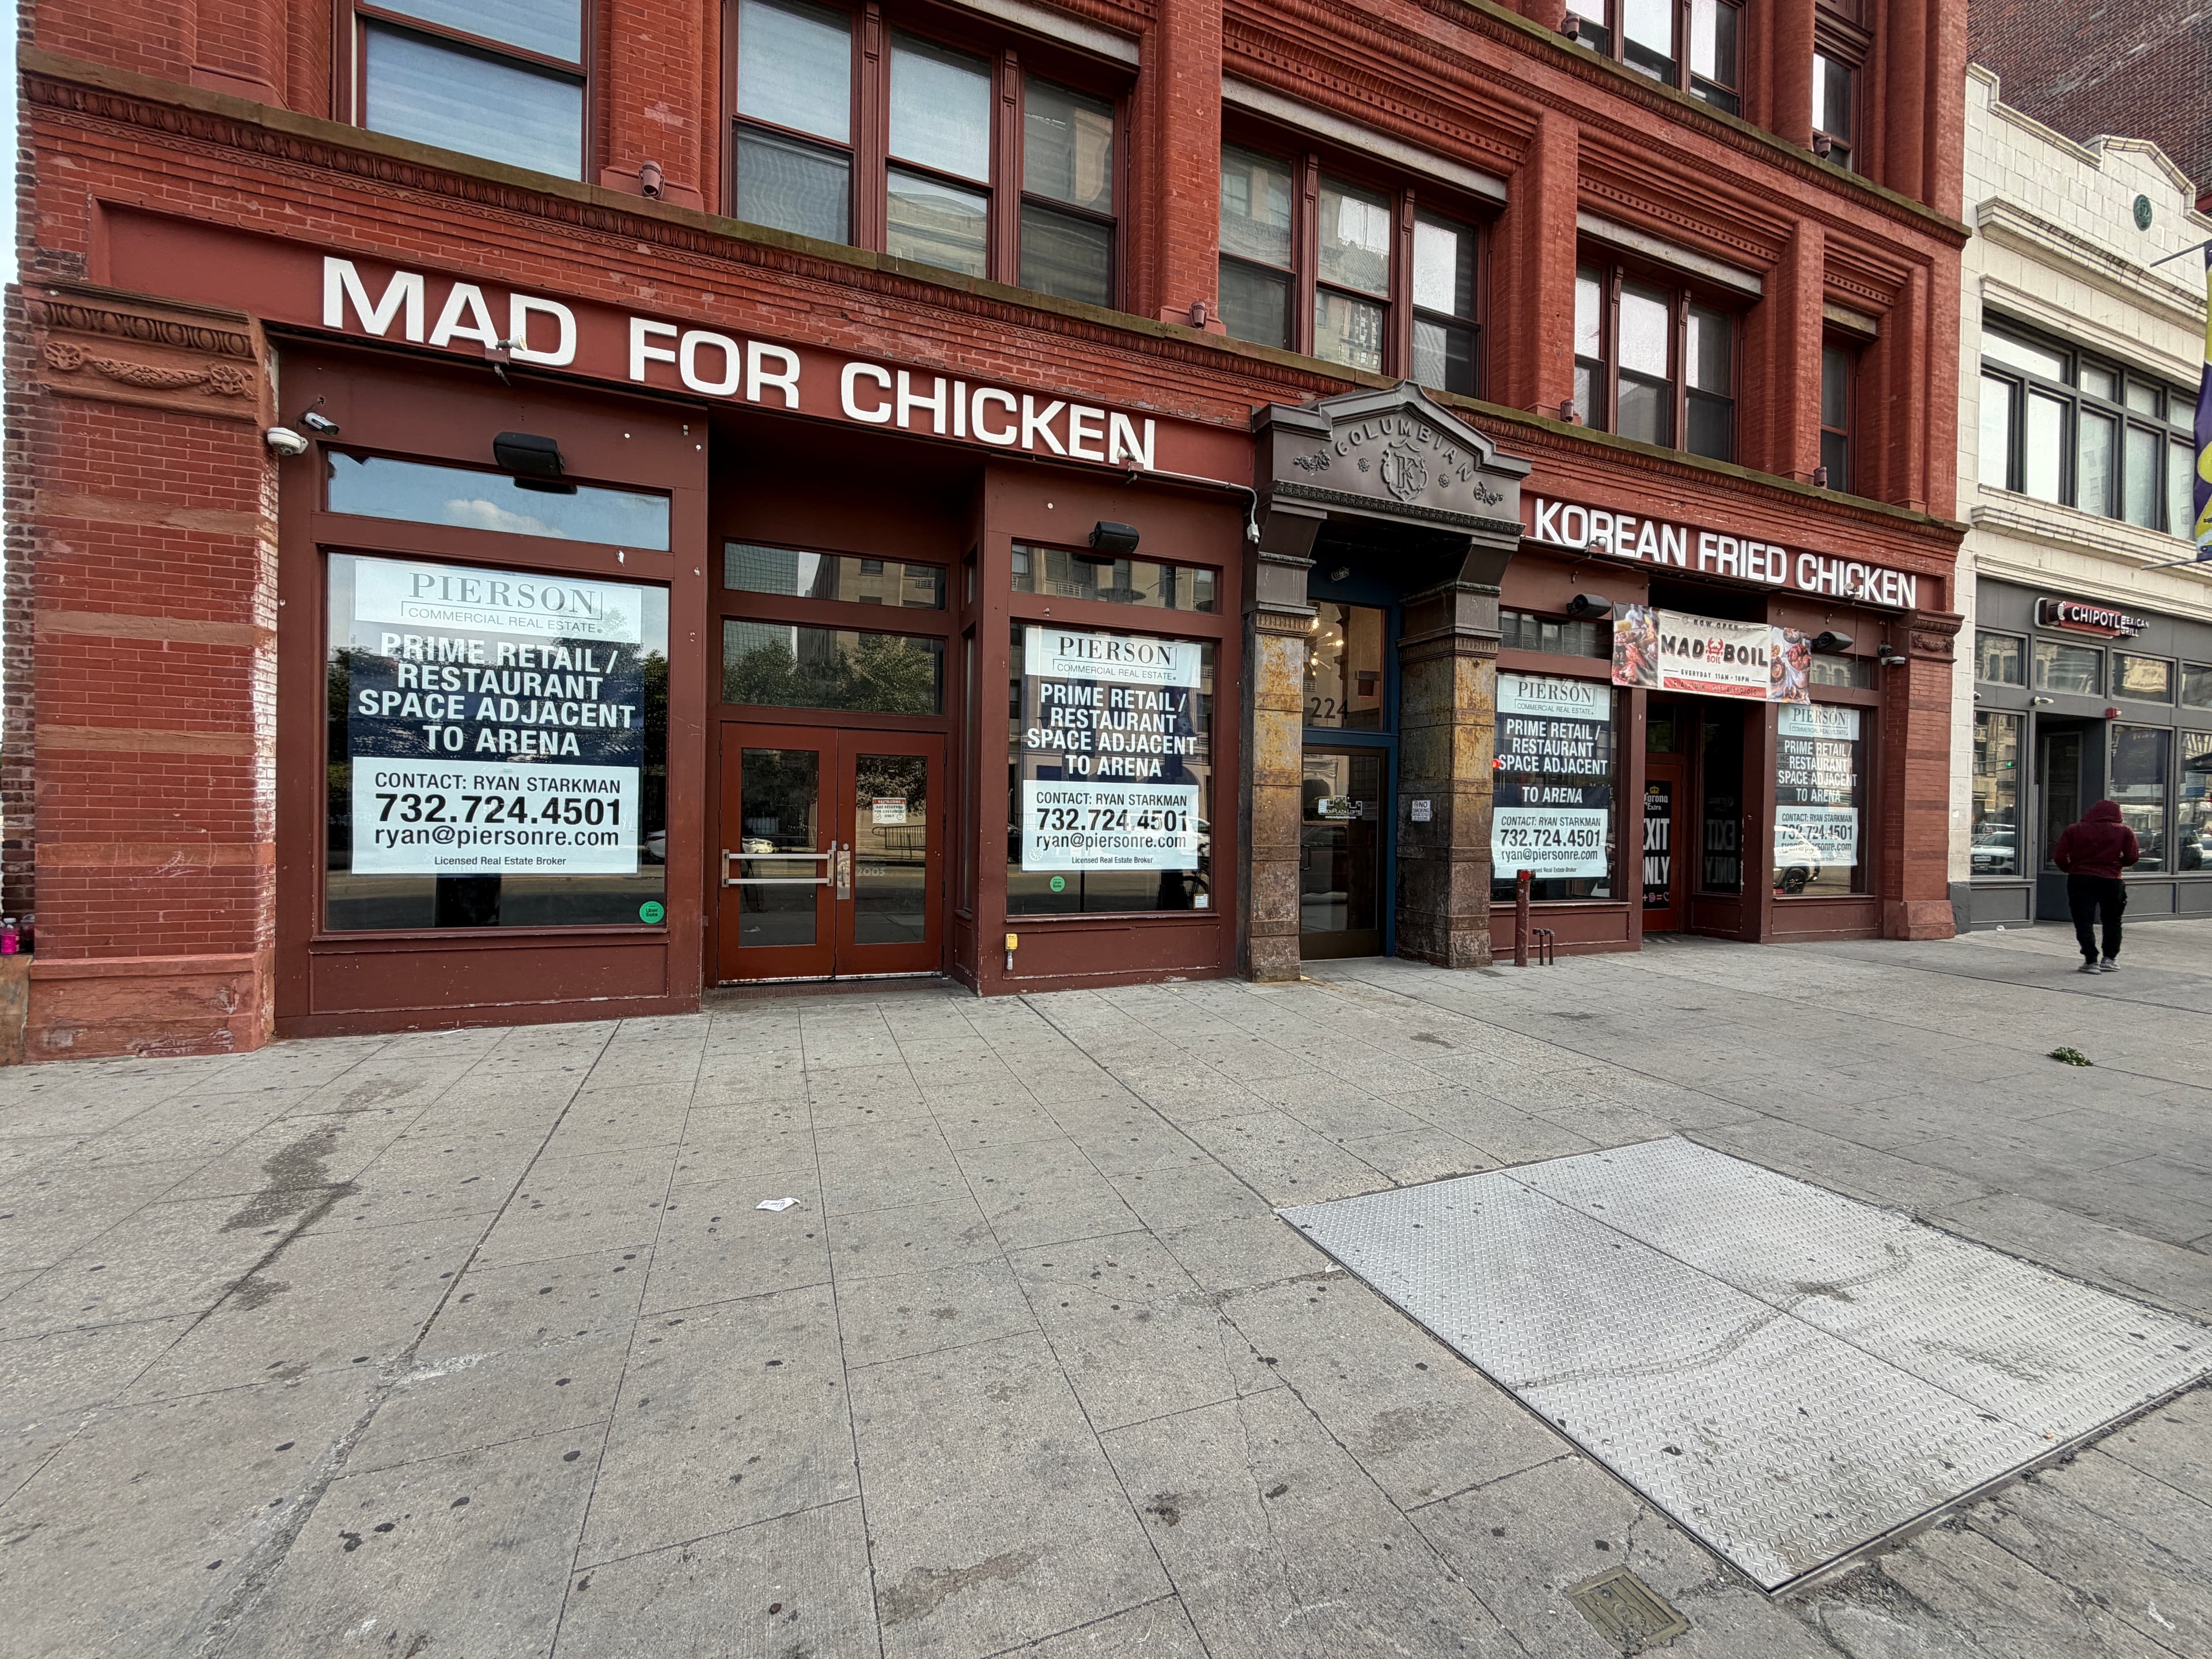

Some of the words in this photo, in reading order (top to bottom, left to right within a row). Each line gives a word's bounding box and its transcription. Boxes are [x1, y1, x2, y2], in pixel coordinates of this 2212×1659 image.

[323, 256, 577, 366] MAD
[630, 317, 800, 409] FOR
[840, 362, 1155, 471] CHICKEN
[1335, 418, 1473, 482] COLUMBIAN
[1536, 499, 1686, 567] KOREAN
[1698, 531, 1787, 584] FRIED
[1796, 553, 1916, 608] CHICKEN
[409, 572, 594, 615] PIERSON
[408, 608, 502, 626] COMMERCIAL
[509, 615, 543, 628] REAL
[2072, 606, 2127, 629] CHIPOTLE
[380, 632, 485, 666] PRIME
[497, 641, 600, 673] RETAIL
[1058, 636, 1172, 666] PIERSON
[1661, 635, 1705, 660] MAD
[1723, 644, 1769, 668] BOIL
[1707, 655, 1721, 664] BOIL
[1058, 663, 1115, 676] COMMERCIAL
[1118, 668, 1140, 678] REAL
[1681, 669, 1711, 679] EVERYDAY
[397, 663, 604, 700] RESTAURANT
[1517, 681, 1592, 703] PIERSON
[1040, 683, 1104, 708] PRIME
[1111, 689, 1175, 711] RETAIL
[1310, 696, 1349, 719] 224
[1517, 703, 1554, 712] COMMERCIAL
[358, 690, 465, 720] SPACE
[476, 698, 636, 729] ADJACENT
[1050, 707, 1177, 733] RESTAURANT
[1793, 708, 1846, 725] PIERSON
[1507, 719, 1546, 737] PRIME
[1551, 722, 1593, 740] RETAIL
[423, 725, 463, 751] TO
[475, 728, 581, 756] ARENA
[1027, 728, 1092, 750] SPACE
[1099, 733, 1196, 755] ADJACENT
[1512, 737, 1594, 757] RESTAURANT
[1785, 740, 1813, 755] PRIME
[1816, 743, 1847, 757] RETAIL
[1065, 755, 1090, 775] TO
[1098, 757, 1161, 777] ARENA
[1498, 754, 1539, 772] SPACE
[1543, 757, 1608, 775] ADJACENT
[1789, 756, 1847, 772] RESTAURANT
[375, 772, 467, 790] CONTACT:
[474, 775, 520, 791] RYAN
[527, 777, 620, 794] STARKMAN
[1778, 770, 1808, 785] SPACE
[1811, 772, 1857, 786] ADJACENT
[1037, 791, 1092, 805] CONTACT:
[1096, 793, 1124, 805] RYAN
[1128, 794, 1187, 806] STARKMAN
[1522, 786, 1539, 802] TO
[1542, 787, 1583, 803] ARENA
[1796, 788, 1808, 801] TO
[1811, 789, 1840, 802] ARENA
[375, 793, 620, 826] 732.724.4501
[1037, 808, 1187, 832] 732.724.4501
[1782, 813, 1809, 822] CONTACT:
[1810, 814, 1823, 822] RYAN
[1824, 814, 1852, 823] STARKMAN
[1501, 816, 1536, 826] CONTACT:
[1539, 817, 1557, 826] RYAN
[1560, 817, 1600, 827] STARKMAN
[1782, 824, 1852, 840] 732724.4501
[375, 825, 619, 849] ryan@piersonre.com
[1037, 832, 1186, 851] ryan@piersonre.com
[1501, 829, 1600, 847] 732.724.4501
[434, 856, 478, 866] Licensed
[481, 857, 501, 866] Real
[505, 857, 533, 866] Estate
[536, 857, 566, 866] Broker
[1072, 856, 1098, 864] Licensed
[1100, 856, 1113, 864] Real
[1134, 857, 1153, 865] Broker
[1502, 848, 1597, 862] ryan@piersonre.com
[857, 866, 885, 876] 2005
[1643, 857, 1670, 885] NLY
